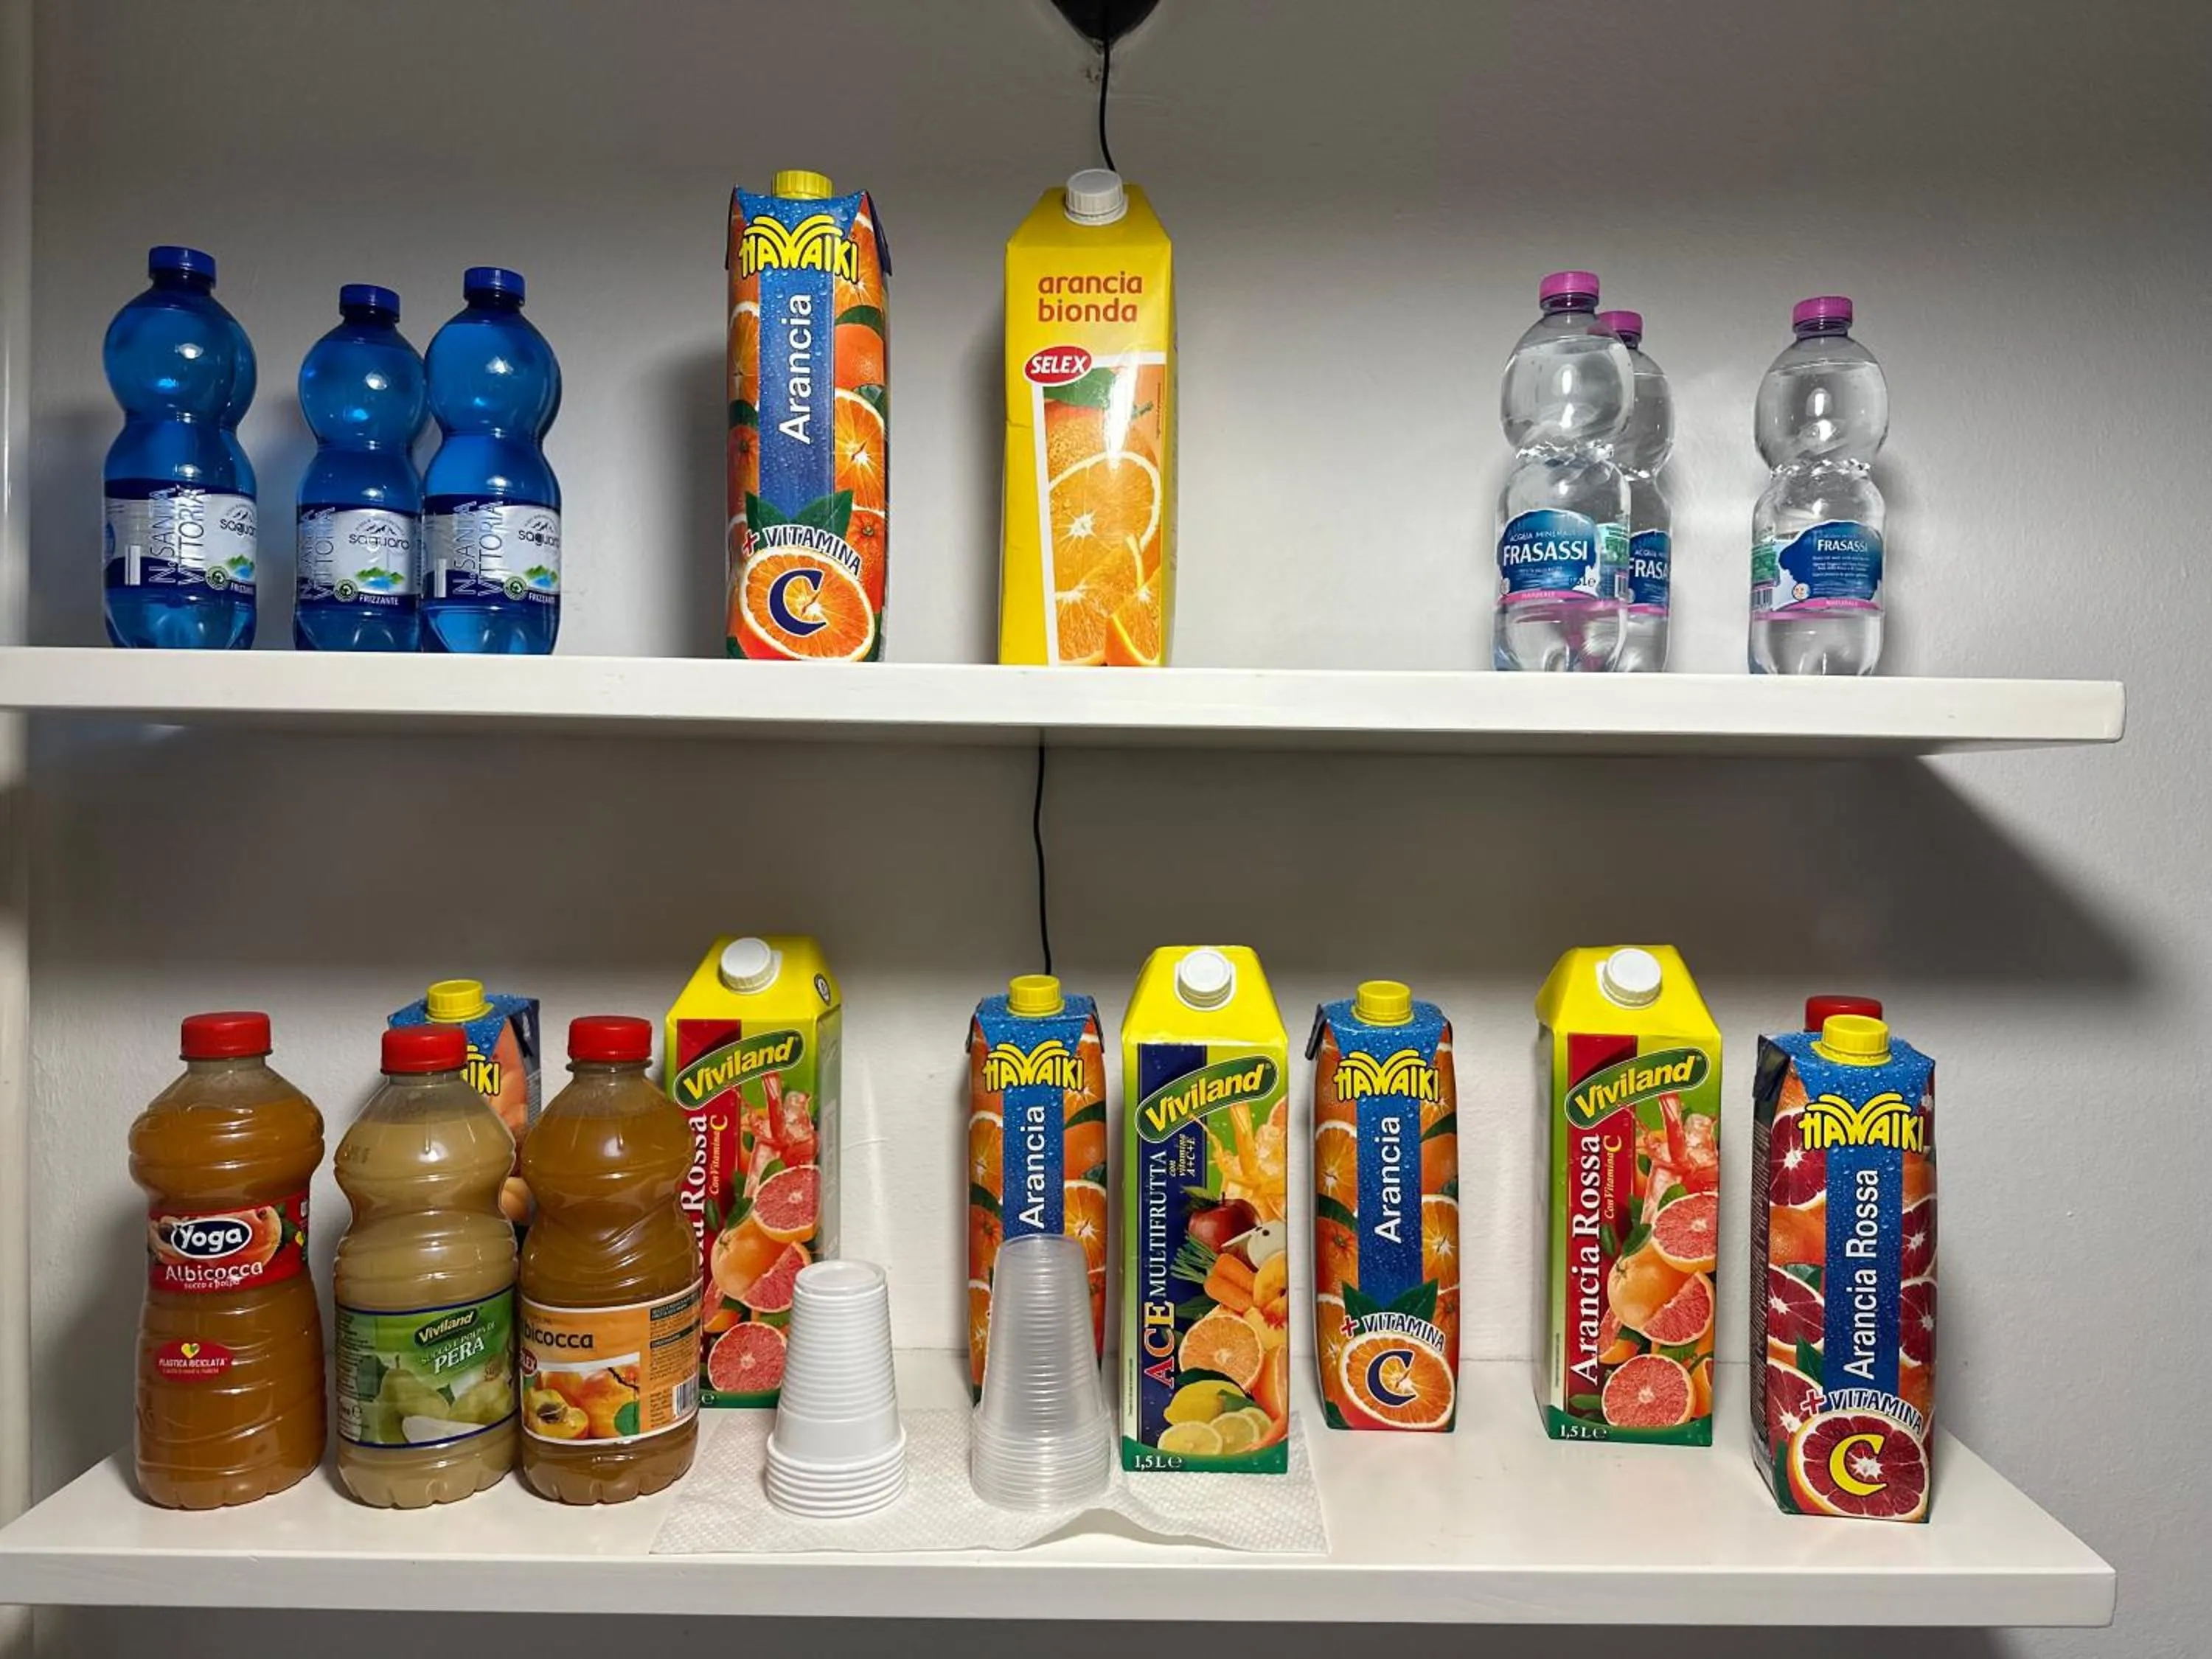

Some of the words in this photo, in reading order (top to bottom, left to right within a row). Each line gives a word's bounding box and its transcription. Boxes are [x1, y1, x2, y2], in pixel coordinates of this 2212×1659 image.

[739, 215, 859, 284] HAWAIKI
[1038, 271, 1142, 293] arancia
[1038, 298, 1137, 322] bionda
[779, 295, 811, 445] Arancia
[1031, 355, 1088, 375] SELEX
[349, 533, 410, 551] saguaro
[762, 525, 863, 580] VITAMINA
[1503, 540, 1588, 566] FRASASSI
[1817, 539, 1868, 552] FRASASSI
[768, 568, 829, 637] C
[684, 1036, 796, 1100] Viviland
[982, 1040, 1084, 1092] HAWAIKI
[1333, 1049, 1440, 1103] HAWAIKI
[1574, 1055, 1696, 1119] Viviland
[1145, 1063, 1265, 1133] Viviland
[1798, 1093, 1924, 1154] HAWAIKI
[681, 1114, 707, 1214] Rossa
[1019, 1106, 1045, 1229] Arancia
[1374, 1117, 1401, 1244] Arancia
[1573, 1133, 1601, 1239] Rossa
[178, 1225, 243, 1252] Yoga
[1149, 1150, 1167, 1298] MULTIFRUTTA
[1846, 1169, 1879, 1258] Rossa
[165, 1262, 264, 1282] Albicocca
[417, 1311, 475, 1343] Viviland
[1144, 1301, 1175, 1388] ACE
[1361, 1312, 1446, 1354] VITAMINA
[1571, 1245, 1599, 1386] Arancia
[1843, 1269, 1877, 1380] Arancia
[433, 1336, 484, 1375] PERA
[1366, 1349, 1419, 1408] C
[1829, 1388, 1923, 1437] VITAMINA
[1829, 1433, 1888, 1496] C
